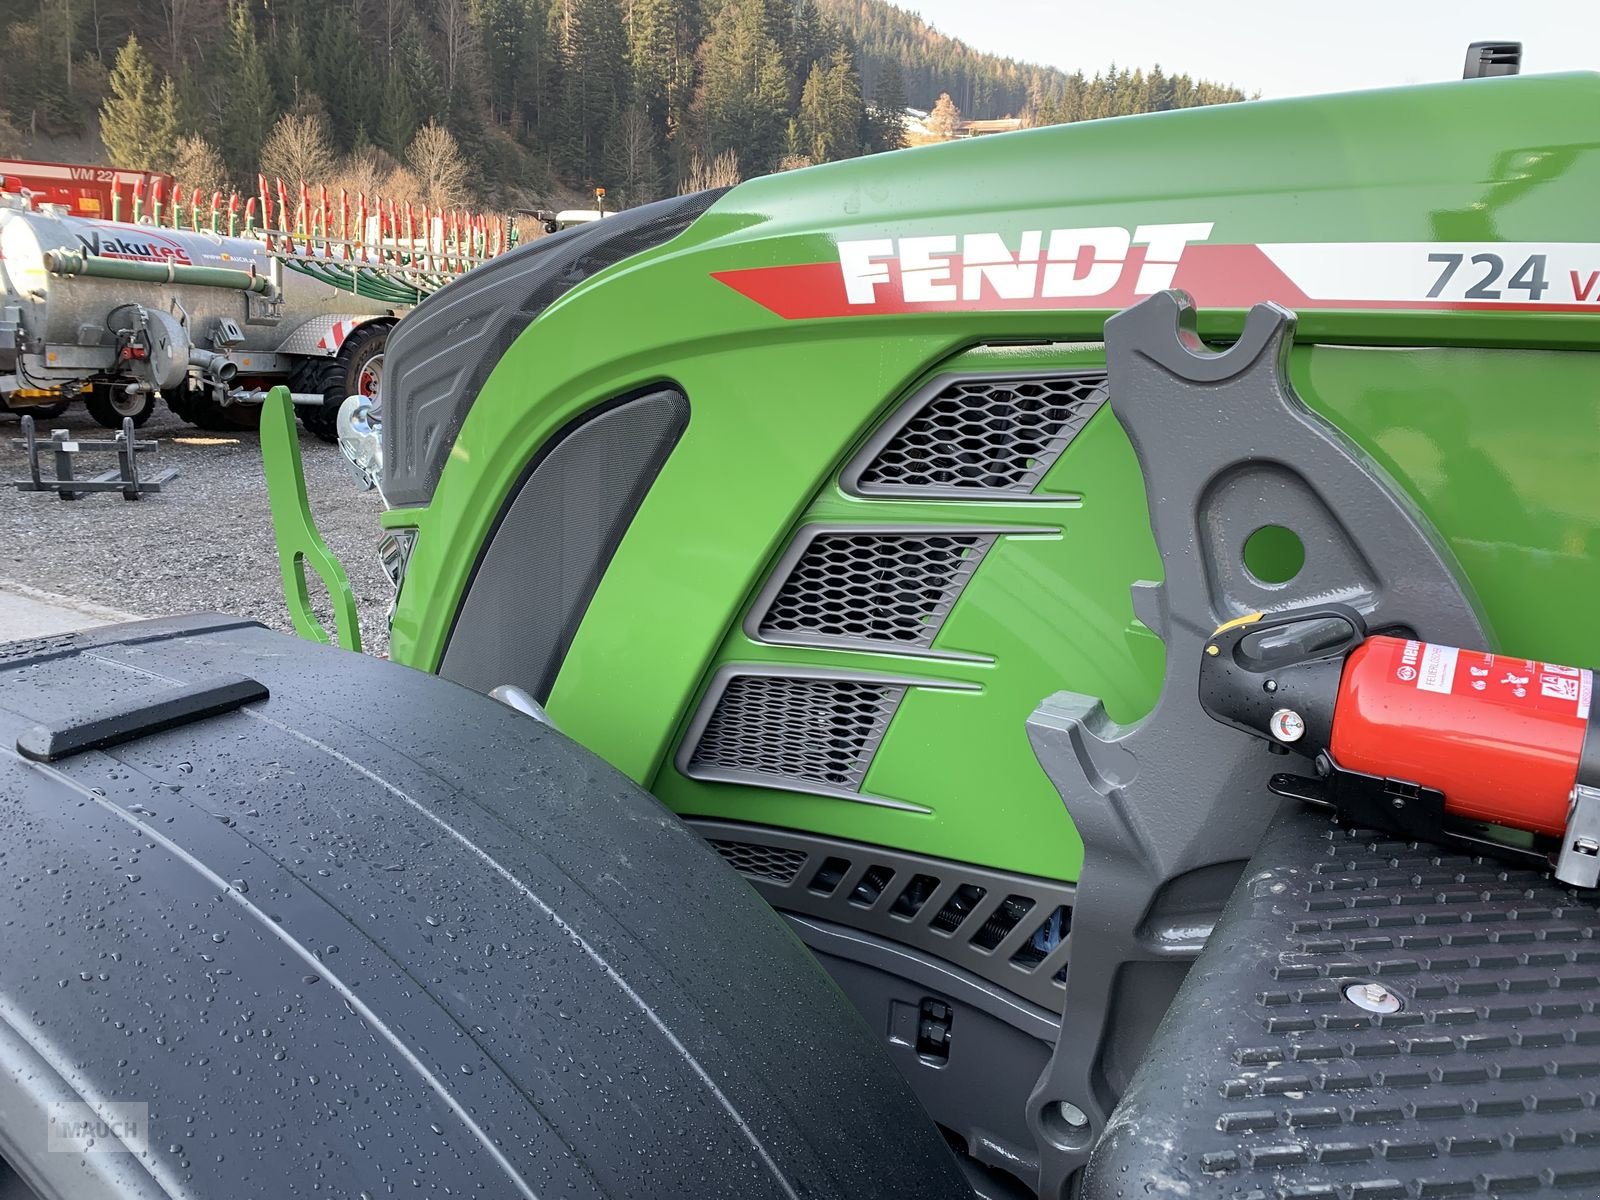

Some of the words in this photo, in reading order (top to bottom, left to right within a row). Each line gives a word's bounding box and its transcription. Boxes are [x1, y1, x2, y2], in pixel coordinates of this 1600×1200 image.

[72, 168, 94, 181] VM
[75, 231, 190, 260] Vakutec
[837, 222, 1215, 304] FENDT
[1425, 253, 1549, 301] 724
